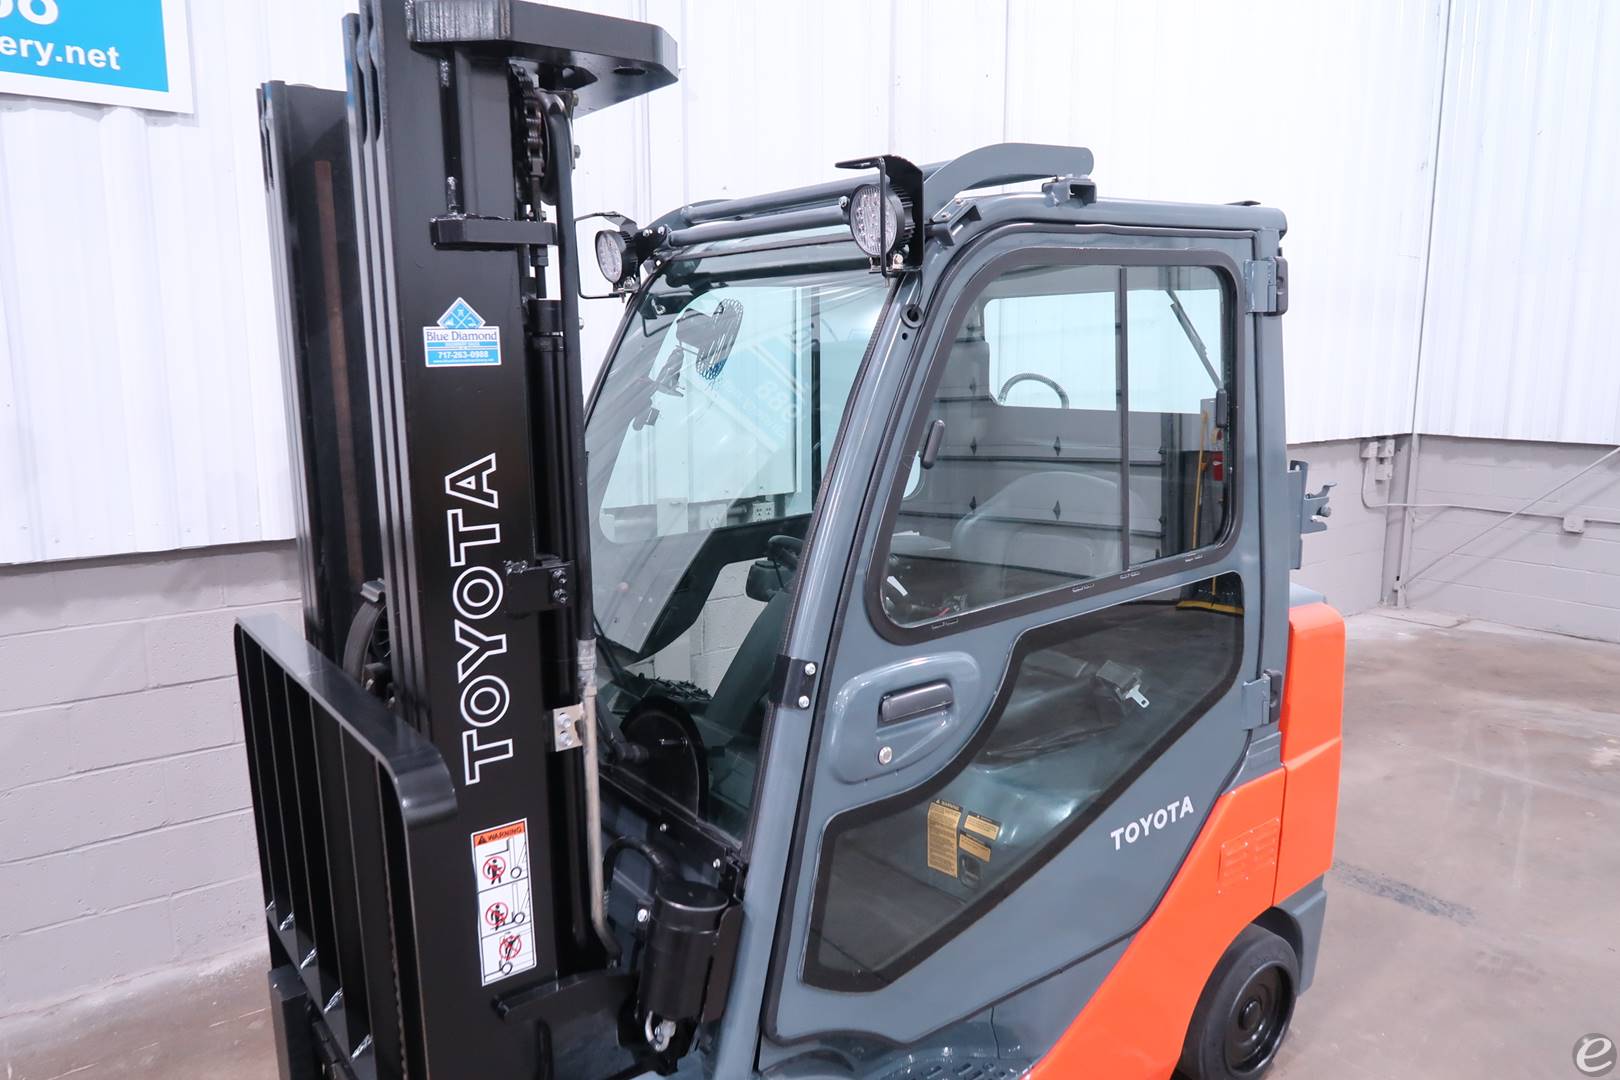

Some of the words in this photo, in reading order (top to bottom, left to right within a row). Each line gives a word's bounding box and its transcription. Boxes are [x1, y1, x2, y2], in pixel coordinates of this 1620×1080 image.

[426, 331, 448, 341] Blue
[451, 331, 497, 341] Diamond
[444, 452, 513, 785] TOYOTA
[488, 826, 522, 841] WARNING
[1110, 795, 1194, 851] TOYOTA
